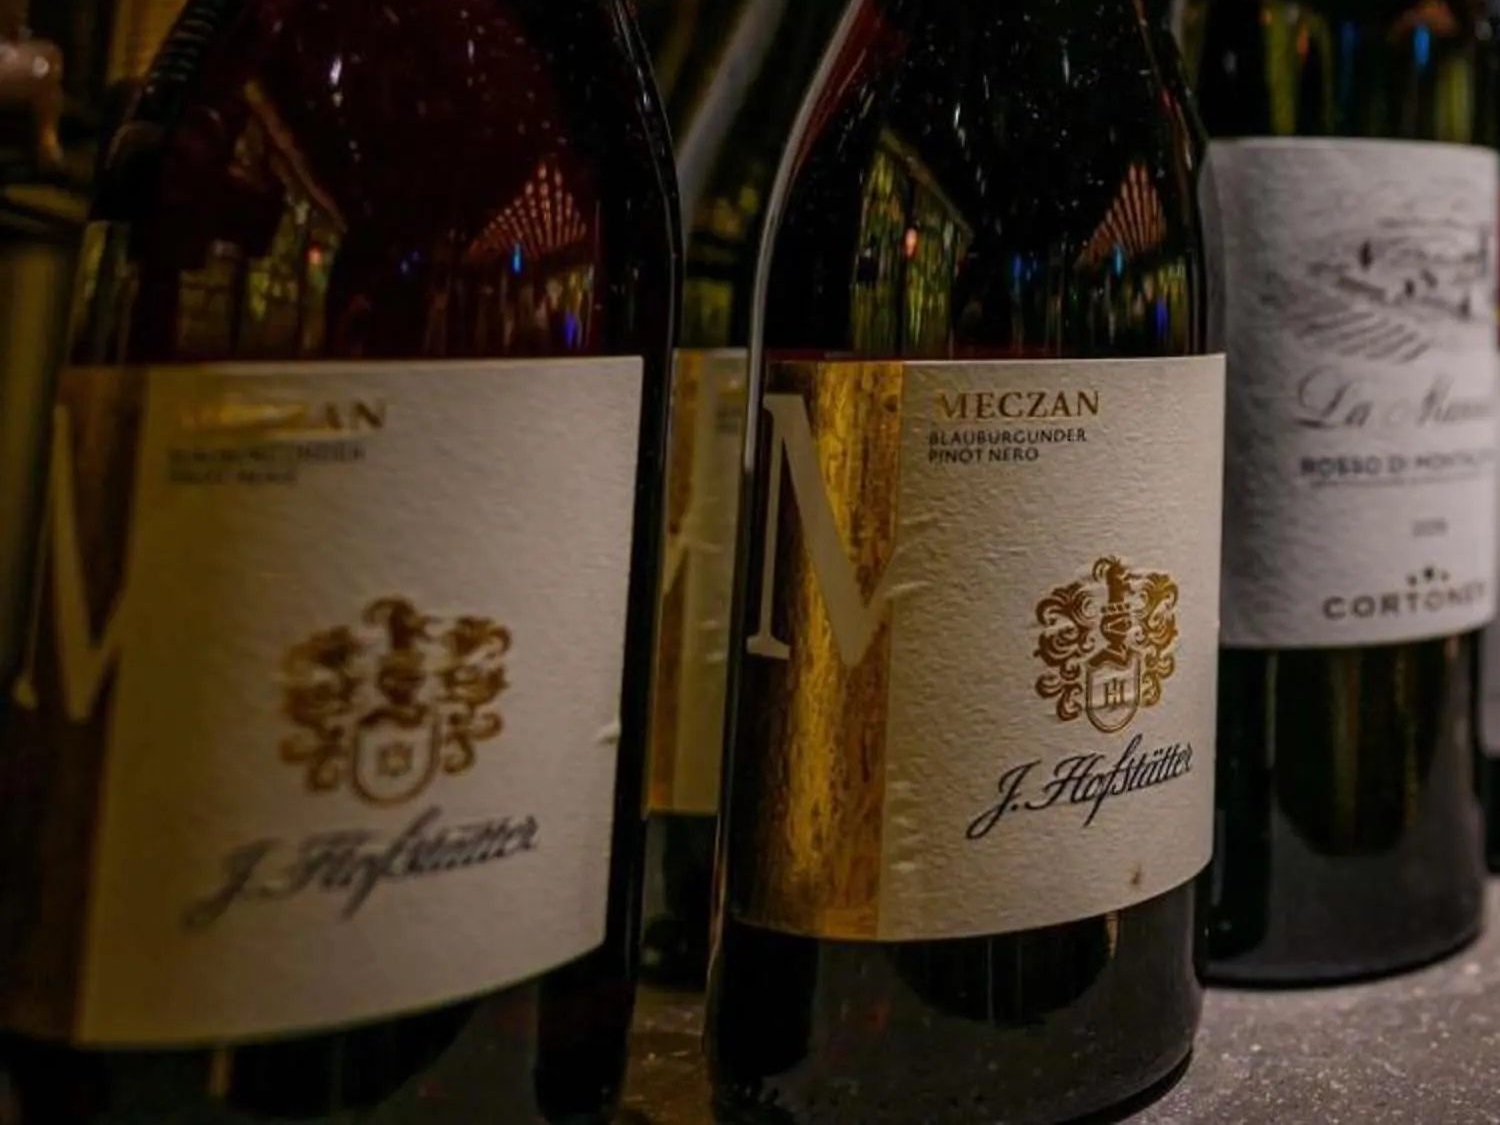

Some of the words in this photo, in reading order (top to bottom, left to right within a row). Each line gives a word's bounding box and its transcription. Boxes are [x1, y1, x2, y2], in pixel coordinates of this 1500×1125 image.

[935, 389, 1101, 420] MECZAN
[929, 429, 1087, 446] BLAUBURGUNDER
[929, 448, 983, 464] PINOT
[988, 448, 1039, 463] NERO
[966, 760, 1041, 840] J.
[1025, 734, 1193, 828] Hofstätter
